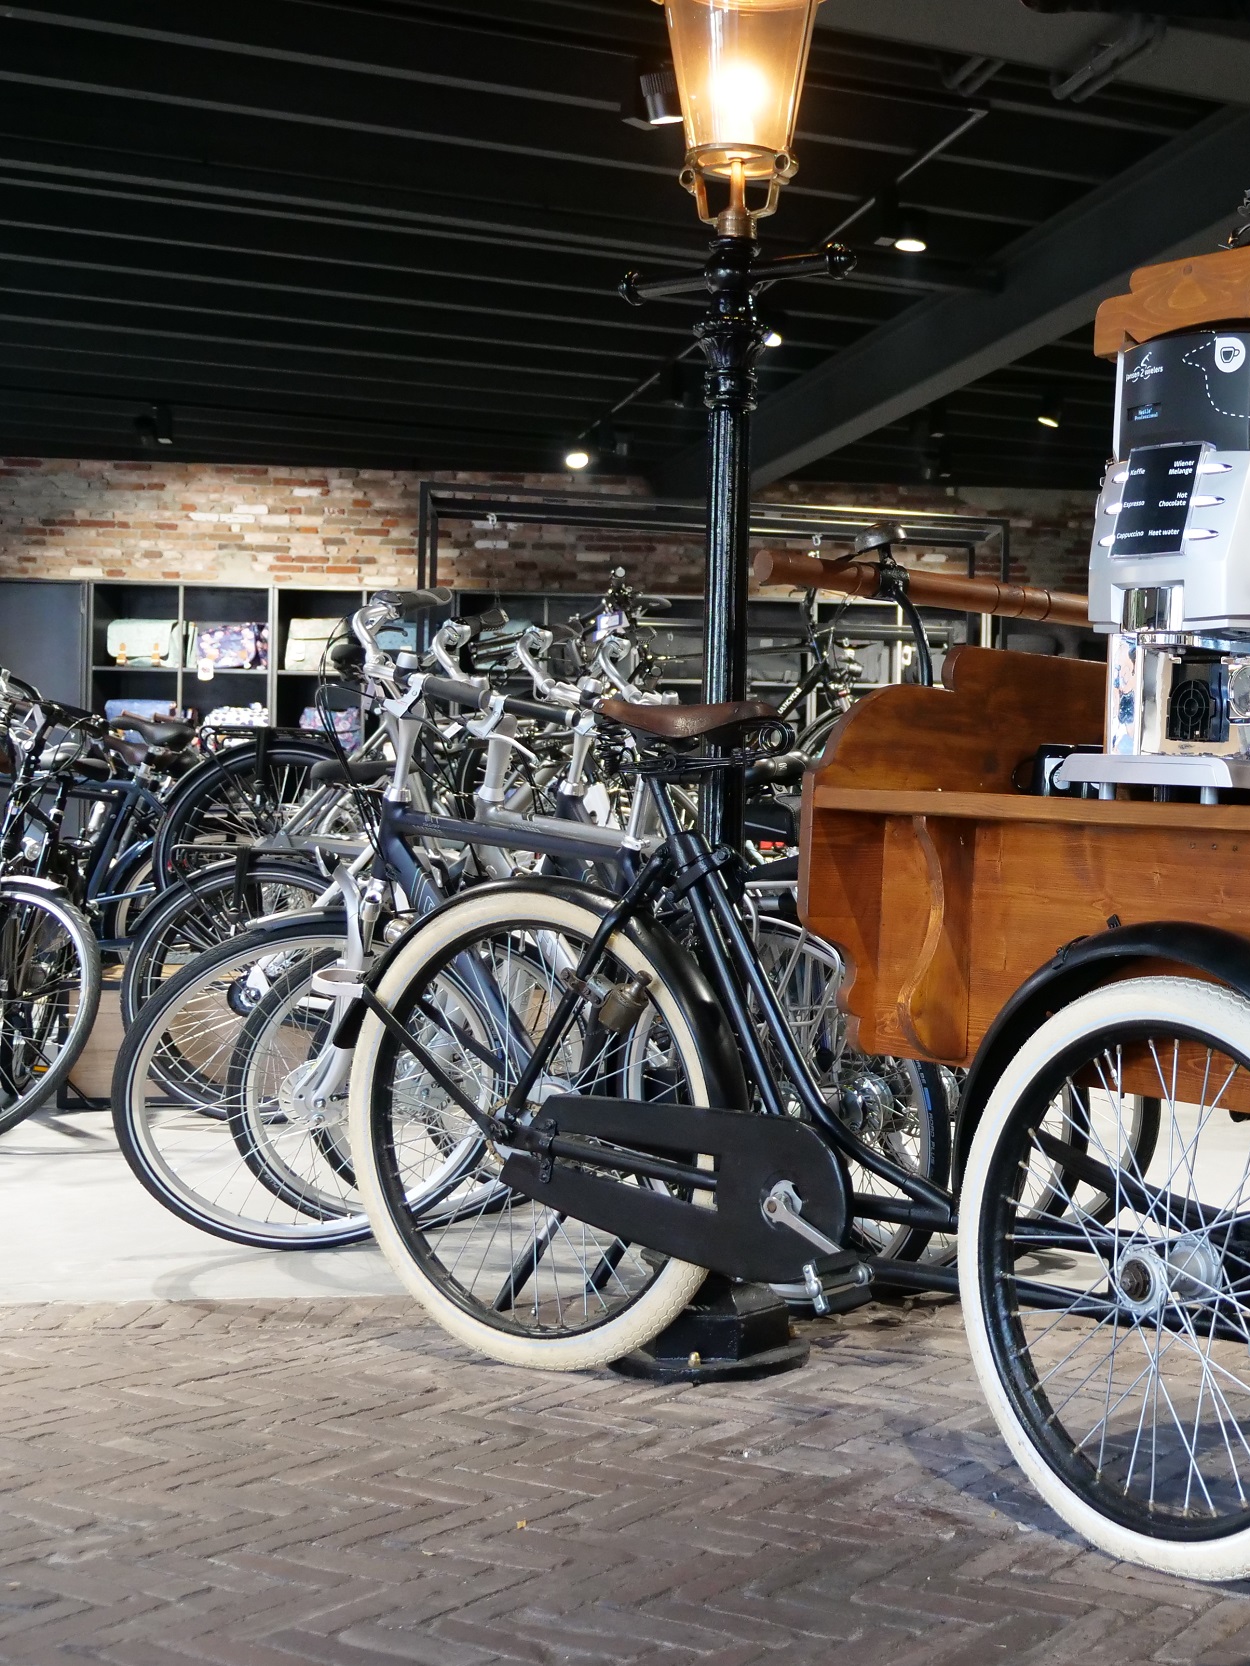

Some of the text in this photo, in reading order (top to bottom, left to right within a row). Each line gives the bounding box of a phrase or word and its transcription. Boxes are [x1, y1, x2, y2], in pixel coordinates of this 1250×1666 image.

[1173, 460, 1195, 468] Wiener
[1129, 468, 1146, 476] Koffie
[1123, 500, 1145, 508] Espresso
[1158, 499, 1187, 507] Chocolate
[1116, 530, 1145, 539] Cappuccino
[776, 686, 803, 715] ULTICYCLE
